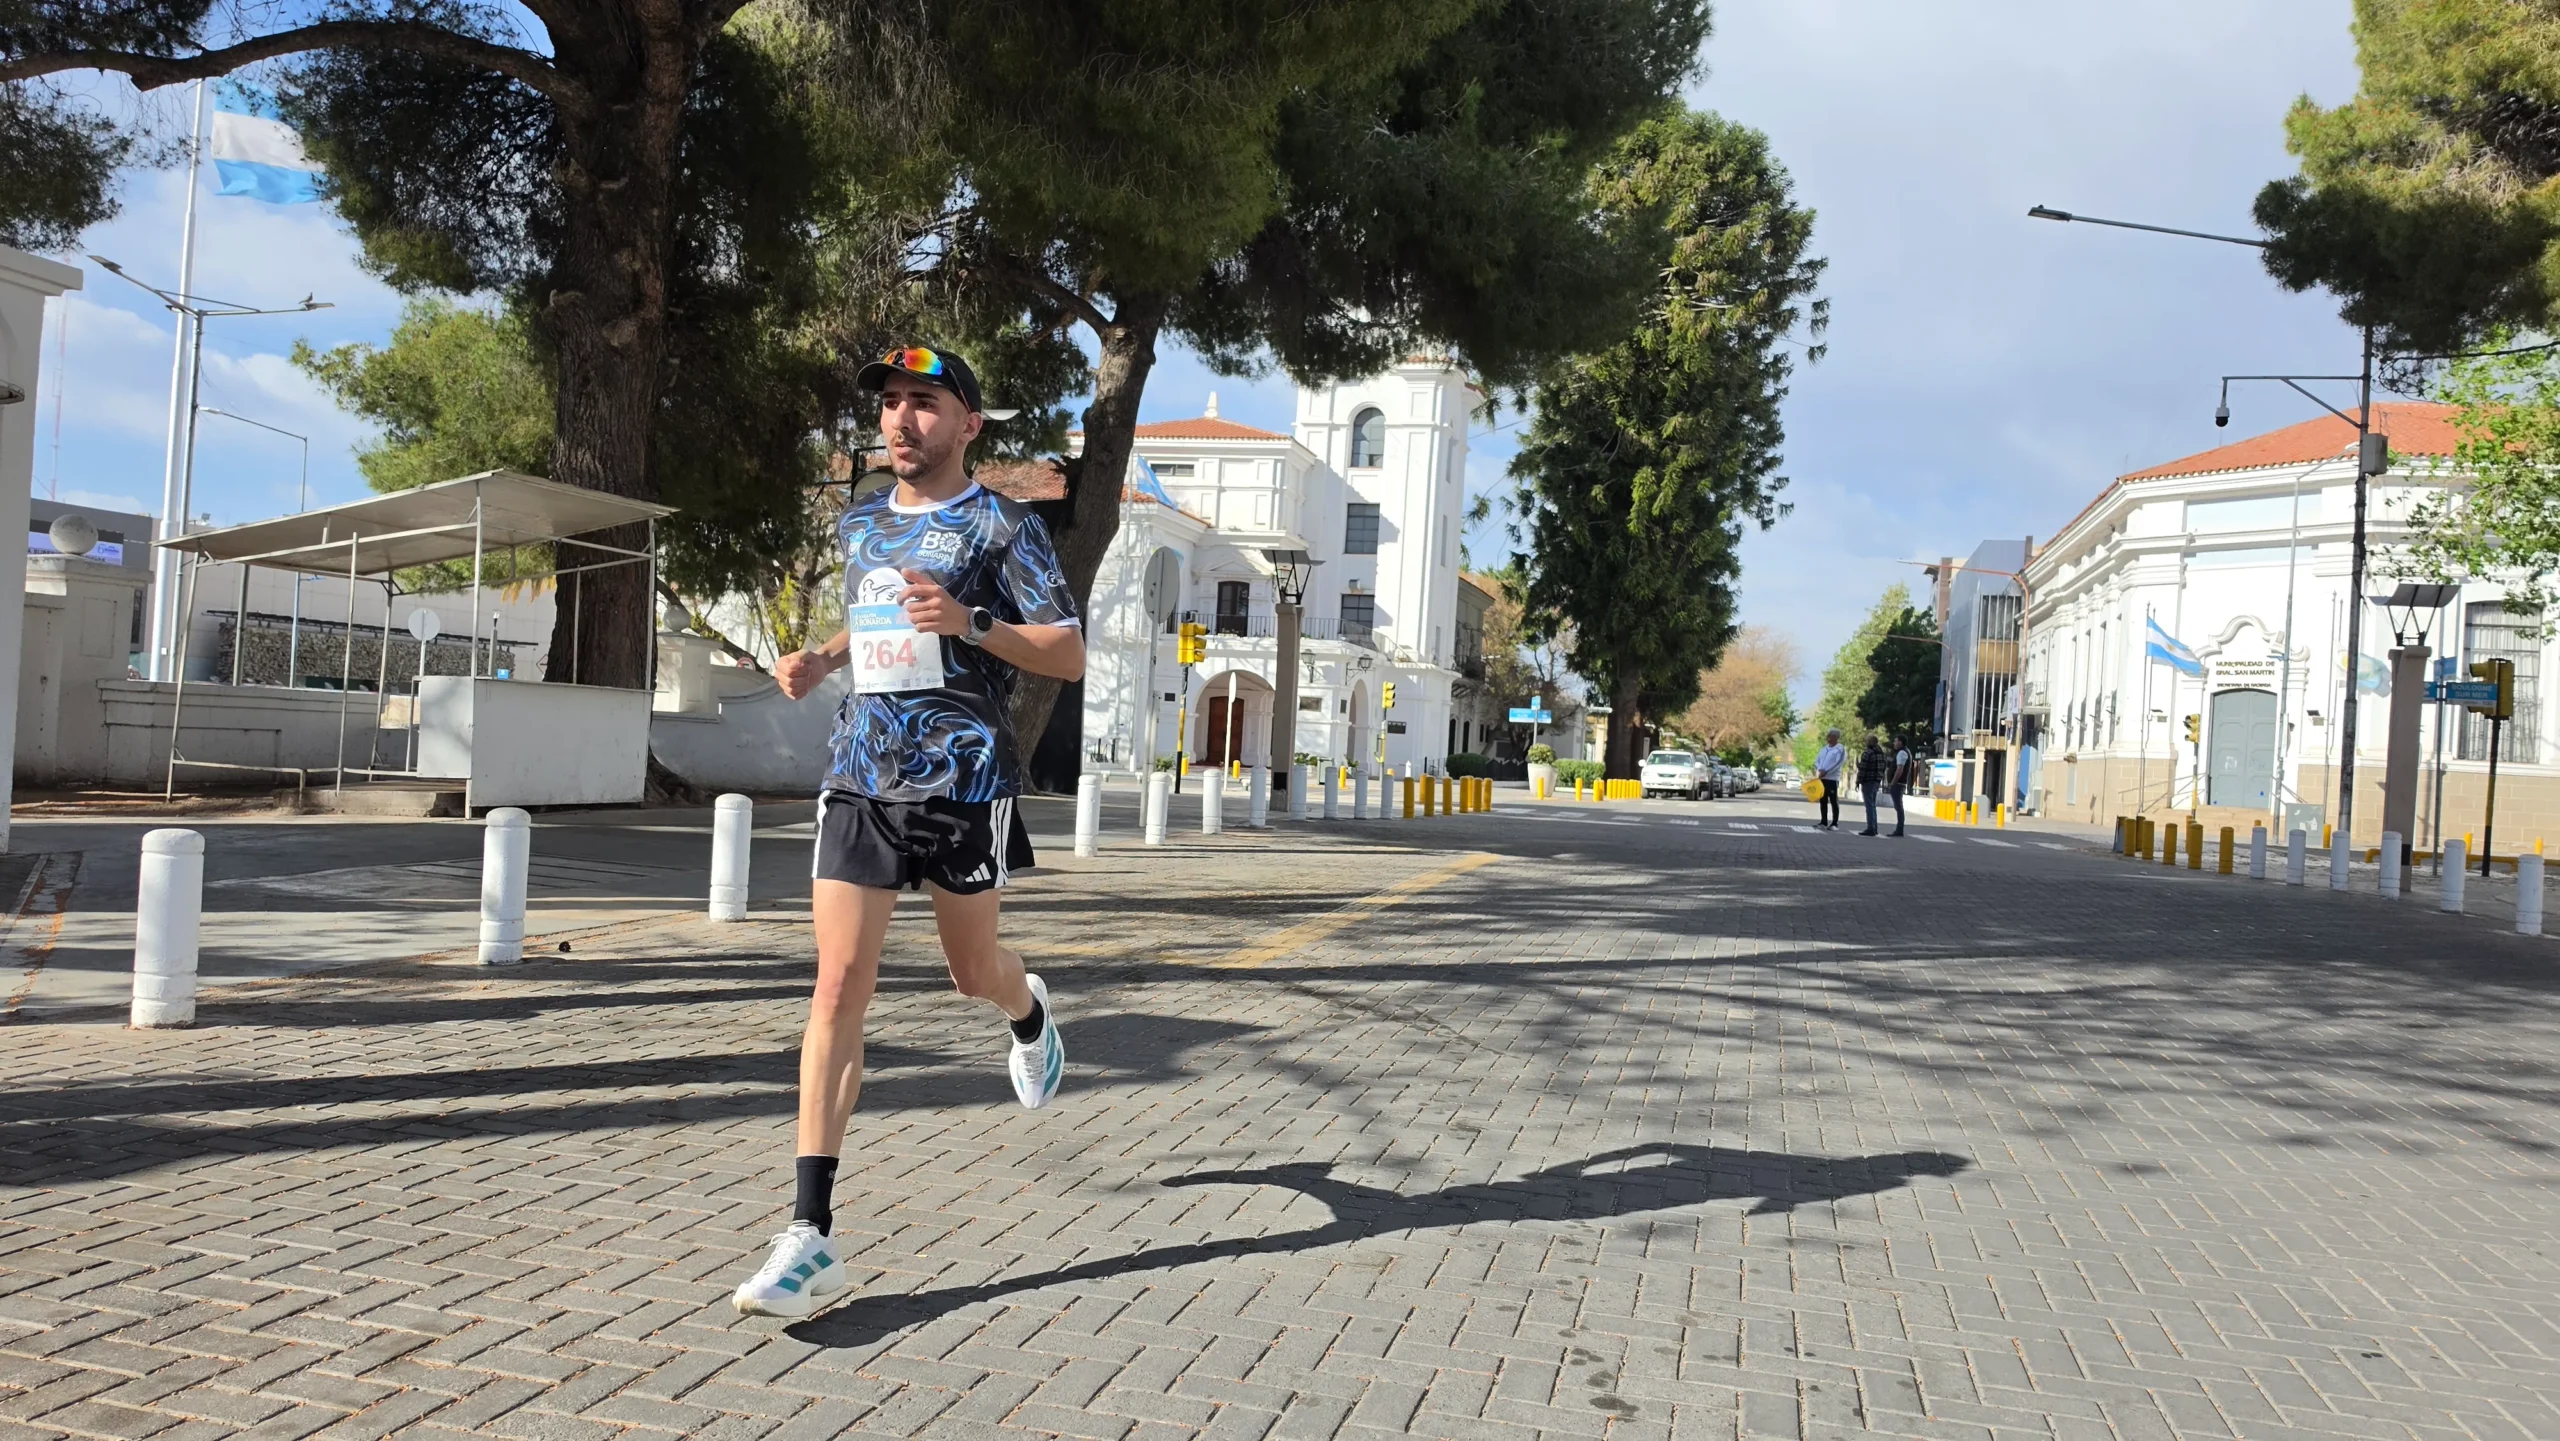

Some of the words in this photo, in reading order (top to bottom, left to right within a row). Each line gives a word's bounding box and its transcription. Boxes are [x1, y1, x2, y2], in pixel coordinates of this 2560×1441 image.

[858, 616, 892, 627] BONARDA
[863, 637, 917, 670] 264
[2451, 684, 2493, 692] BOULOGNE
